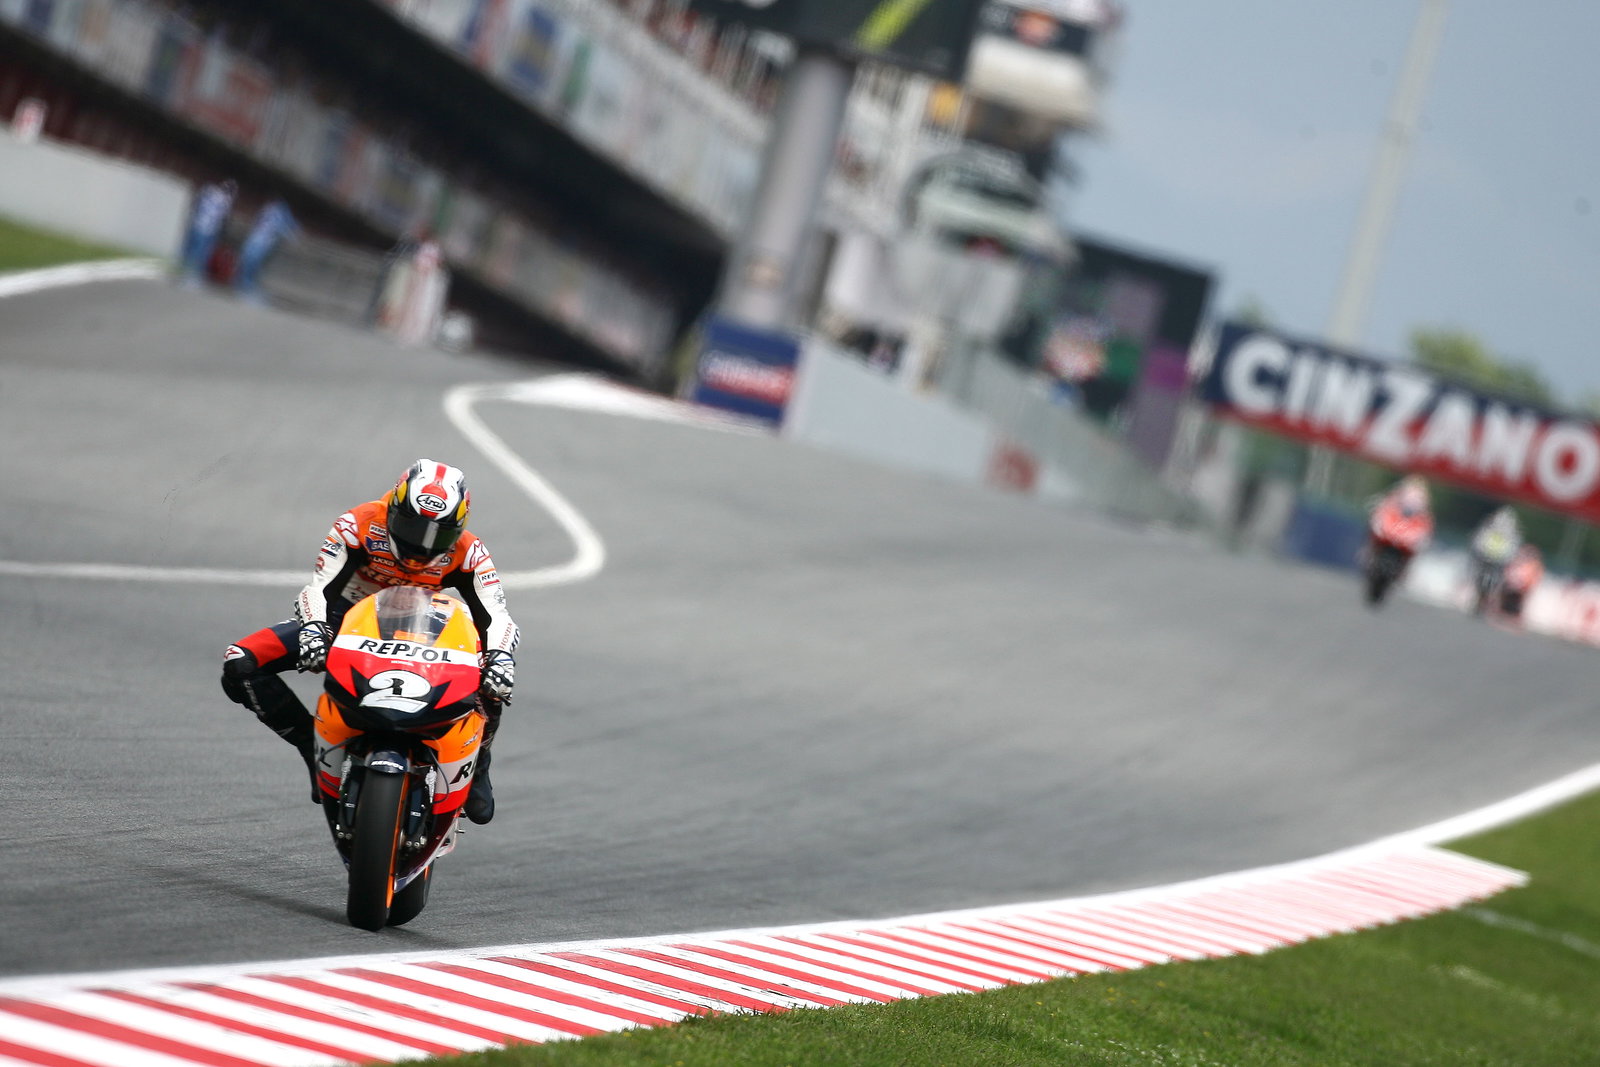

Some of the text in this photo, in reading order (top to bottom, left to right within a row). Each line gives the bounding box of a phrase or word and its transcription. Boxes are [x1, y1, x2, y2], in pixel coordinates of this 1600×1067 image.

[1223, 335, 1599, 501] CINZANO
[418, 496, 443, 509] Arai
[371, 541, 390, 551] GAS
[302, 591, 315, 620] HONDA
[499, 623, 513, 649] HONDA
[358, 640, 452, 663] REPSOL
[359, 670, 432, 714] 2
